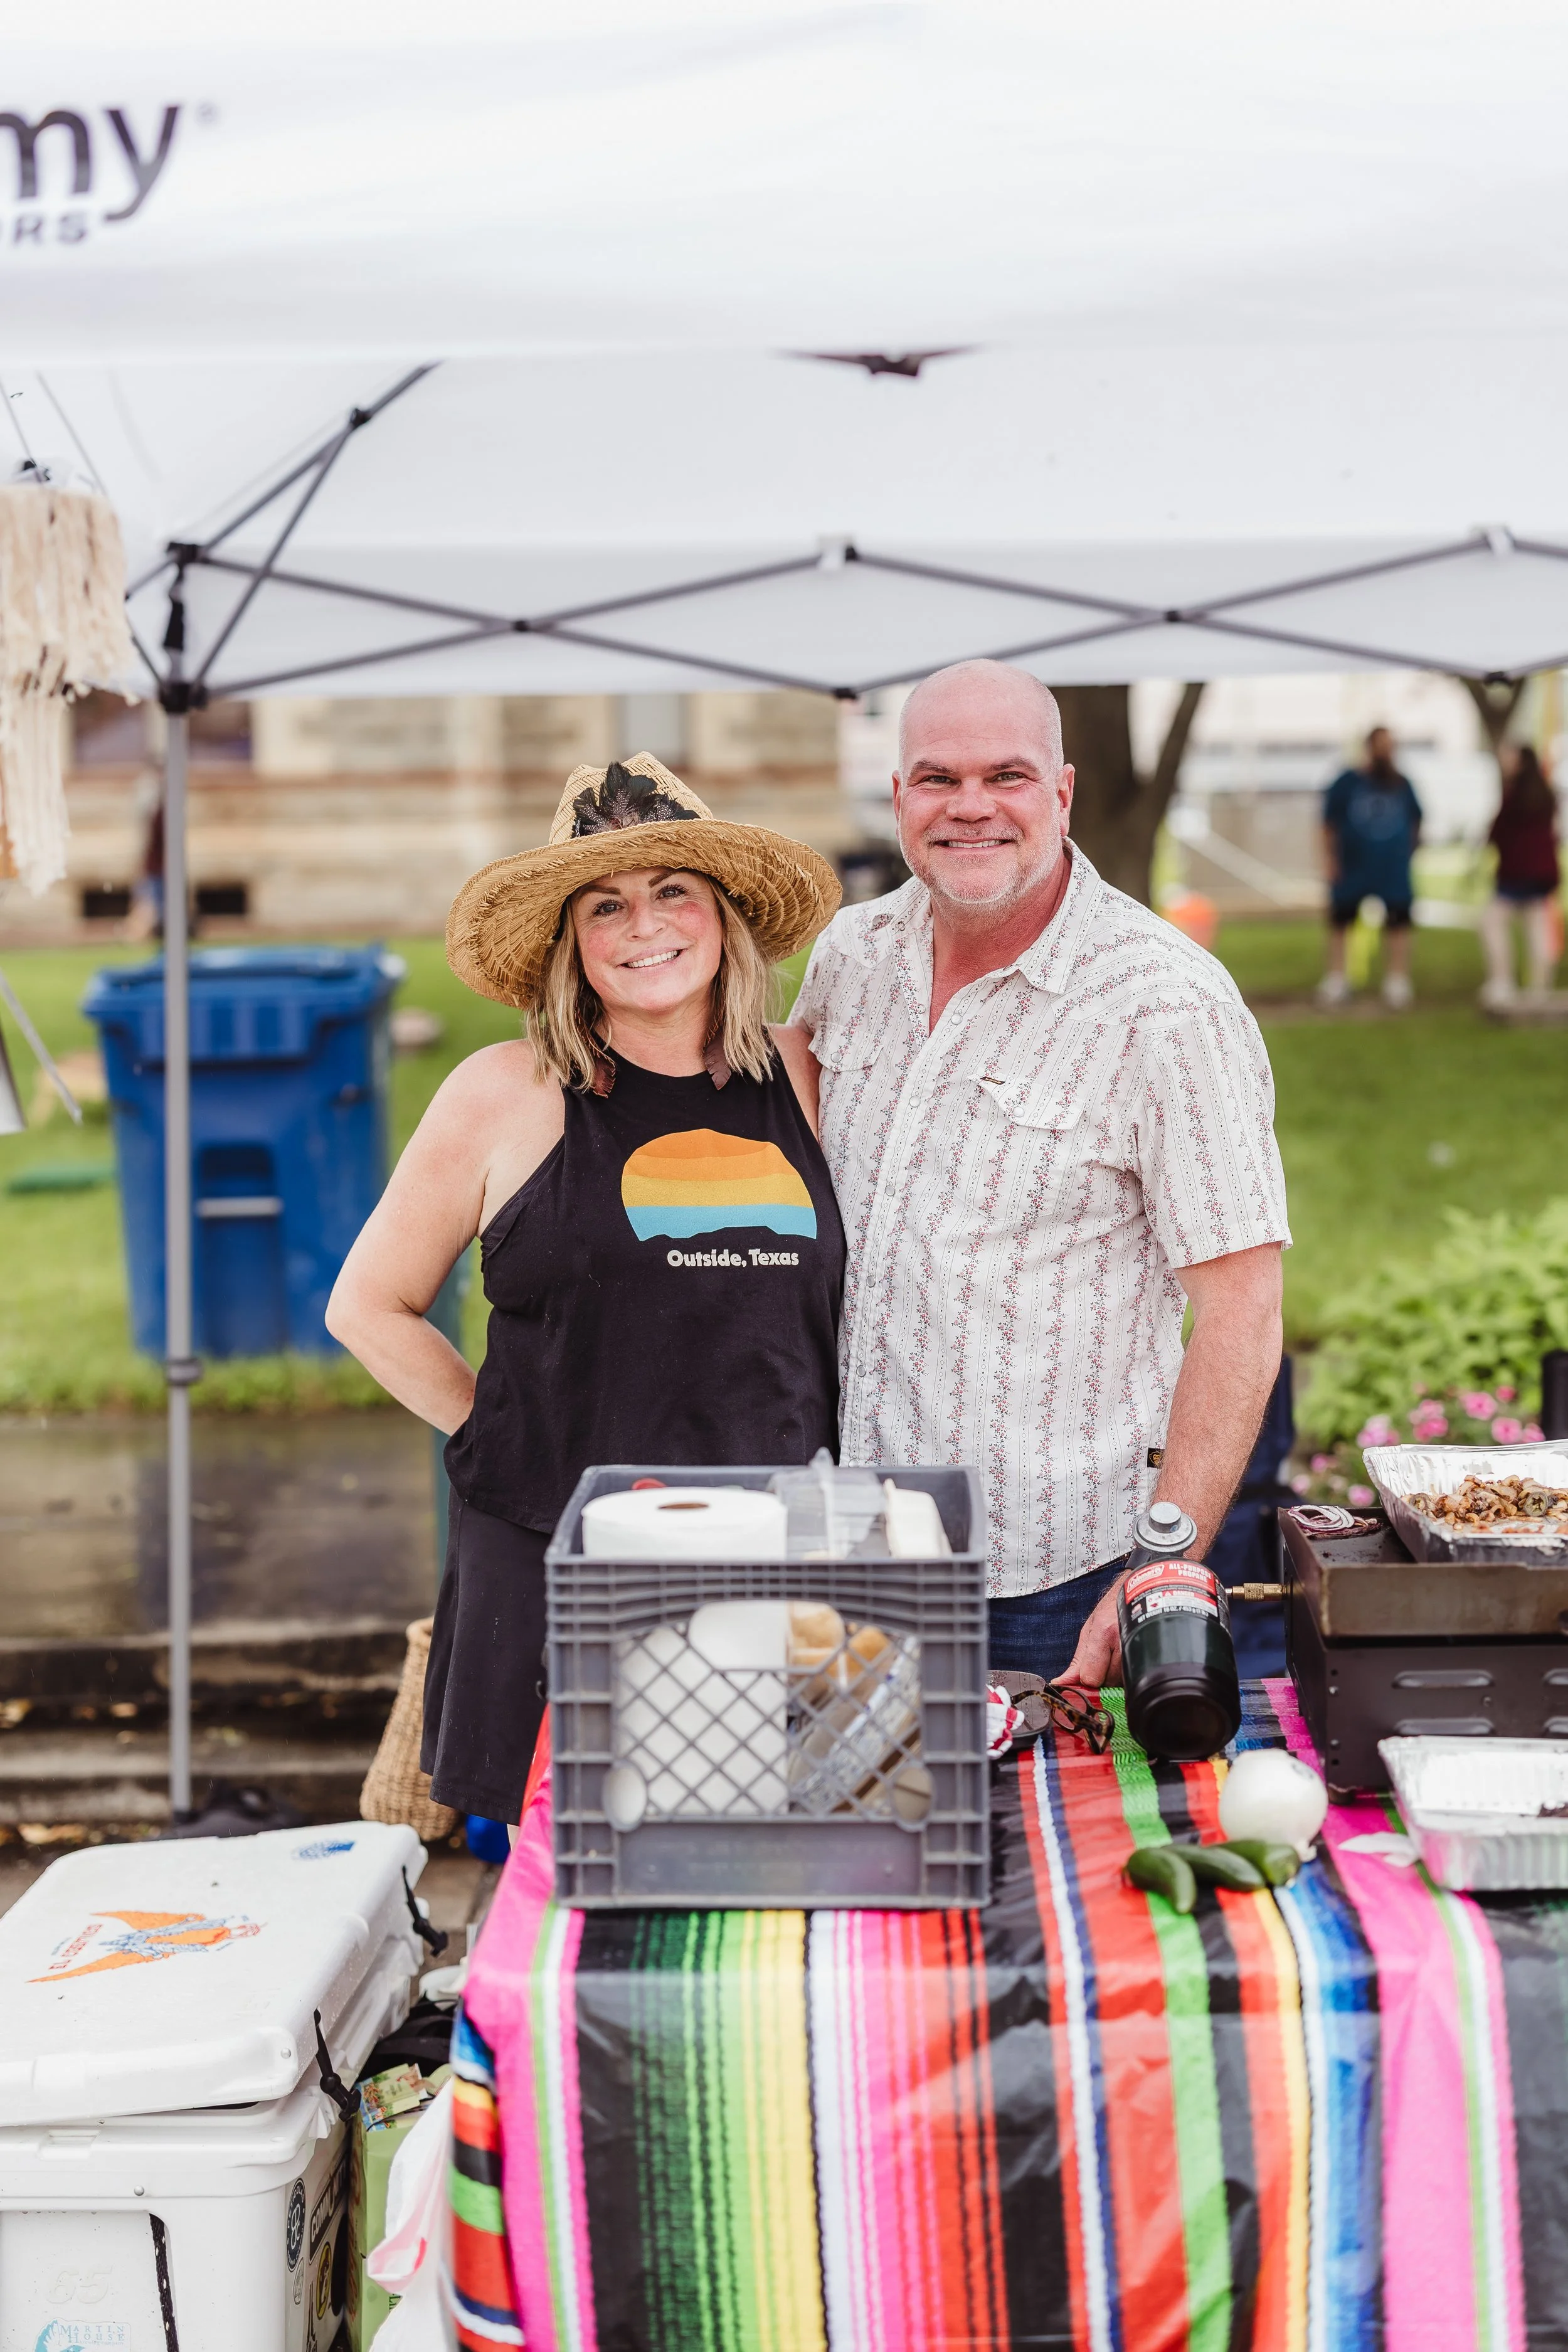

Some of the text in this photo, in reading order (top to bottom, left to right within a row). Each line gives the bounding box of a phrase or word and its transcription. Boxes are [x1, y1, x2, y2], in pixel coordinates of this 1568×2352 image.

[0, 214, 87, 245] RS
[667, 1249, 799, 1267] Outside, Texas
[1168, 1563, 1212, 1579] ALL-PURPOSE
[1178, 1570, 1207, 1582] PROPANE
[46, 2265, 114, 2304] 65
[60, 2324, 124, 2335] MARTIN
[68, 2333, 125, 2343] HOUSE
